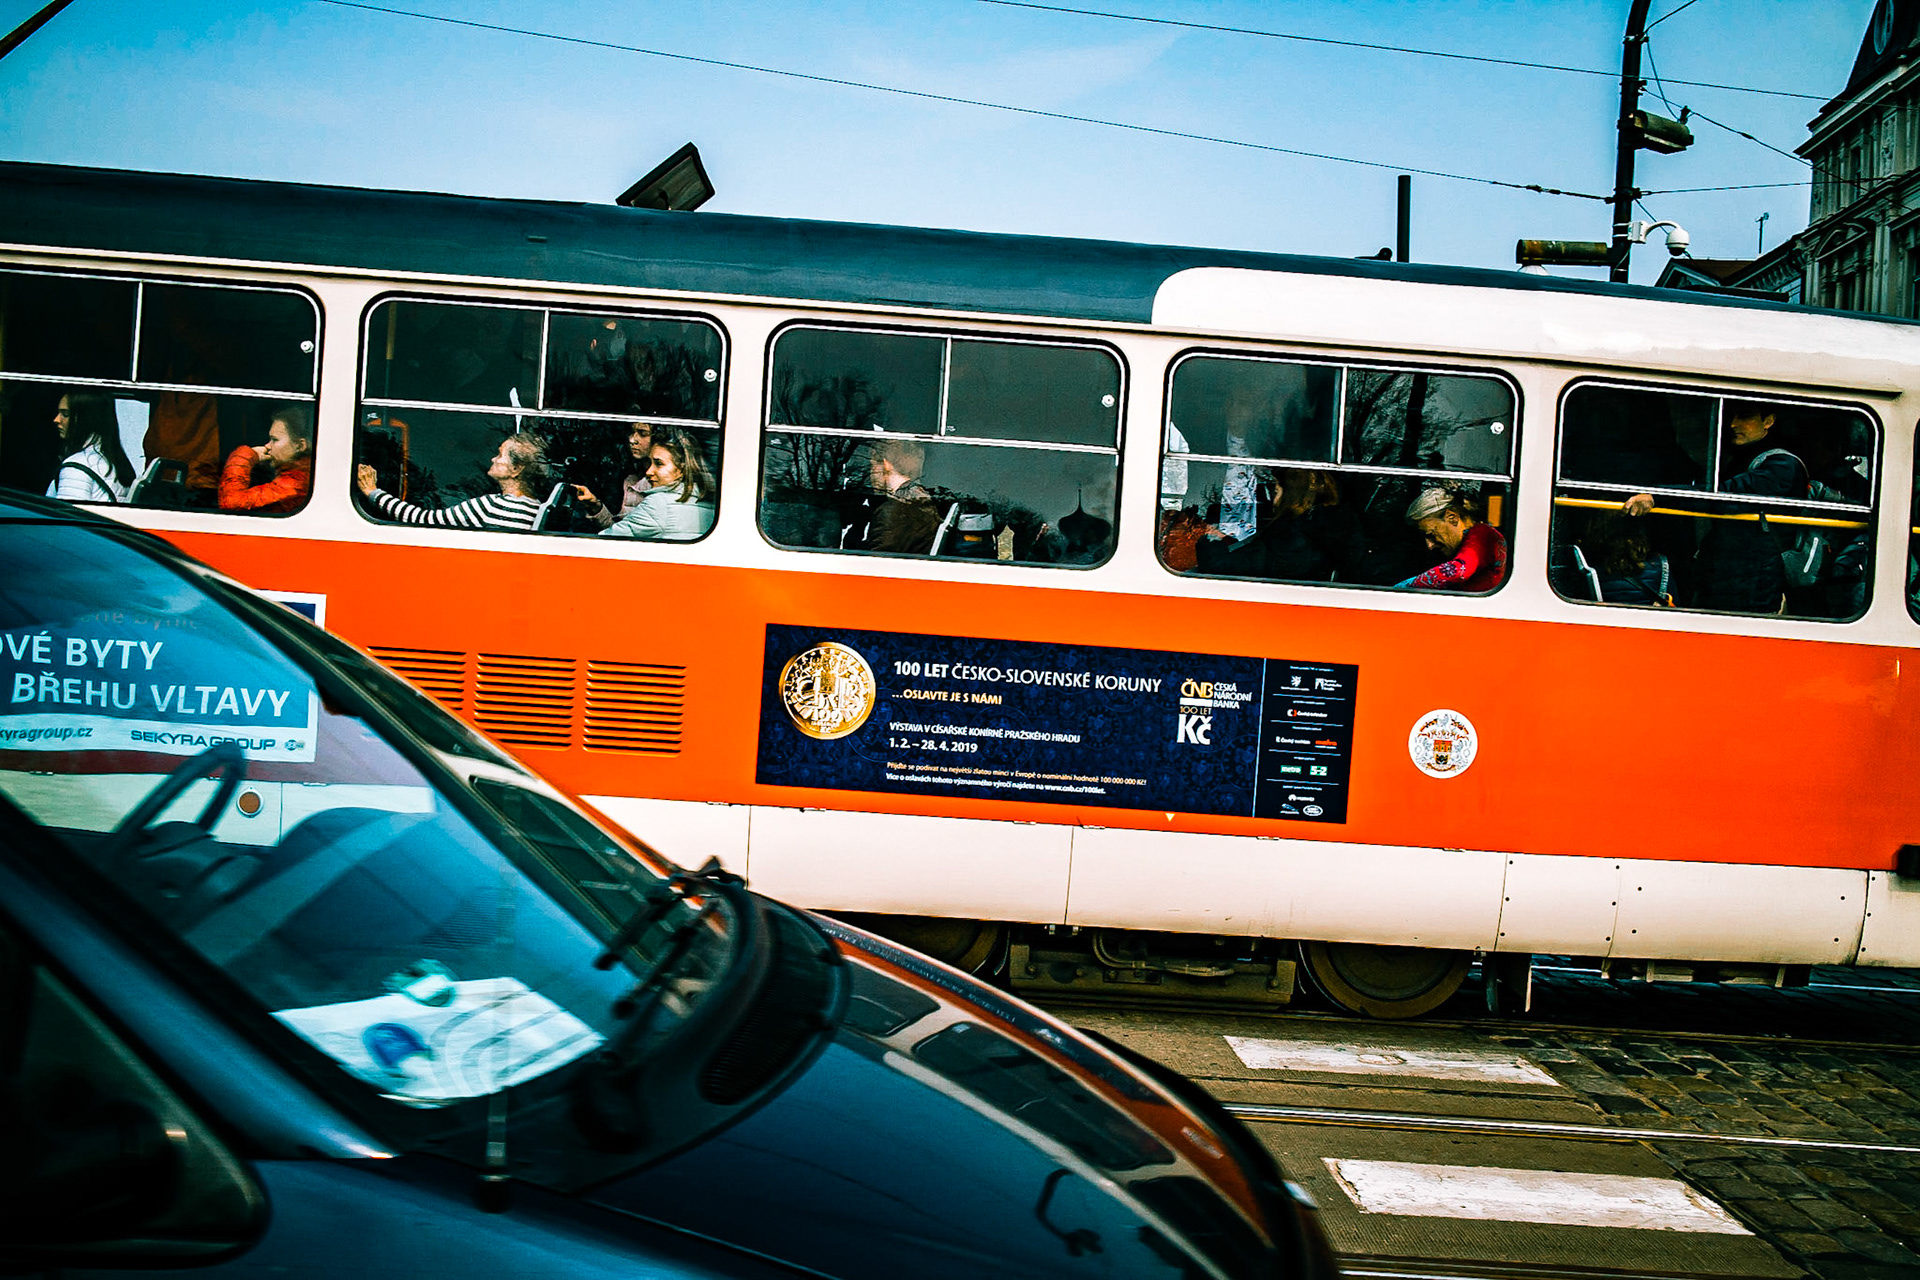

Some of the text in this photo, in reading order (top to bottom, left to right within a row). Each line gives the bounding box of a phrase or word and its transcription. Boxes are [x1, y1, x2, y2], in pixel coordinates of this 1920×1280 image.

[0, 630, 163, 671] VÉ BYTY
[894, 660, 1162, 693] 100 LET ČESKO-SLOVENSKÉ KORUNY
[11, 671, 291, 717] BŘEHU VLTAVY
[1180, 677, 1213, 698] ČNB
[1213, 681, 1237, 692] ČESKÁ
[950, 691, 961, 702] JE
[963, 692, 970, 703] S
[1213, 690, 1252, 701] NÁRODNÍ
[1180, 706, 1212, 715] 100 LET
[1213, 700, 1240, 709] BANKA
[889, 721, 924, 733] VÝSTAVA
[924, 725, 930, 733] V
[1004, 730, 1050, 742] PRAŽSKÉHO
[1051, 733, 1081, 743] HRADU
[1176, 714, 1213, 745] Kč
[889, 738, 899, 748] 1.
[899, 738, 910, 749] 2.
[921, 739, 938, 750] 28.
[938, 741, 949, 751] 4.
[950, 741, 978, 753] 2019
[886, 772, 899, 781] Více
[905, 774, 932, 783] oslavách
[932, 776, 953, 784] tohoto
[953, 777, 993, 787] významného
[1011, 782, 1035, 790] najdete
[972, 767, 992, 775] zlatou
[1014, 770, 1036, 779] Evropě
[1042, 772, 1072, 781] nominální
[1073, 774, 1099, 783] hodnotě
[1100, 776, 1111, 784] 100
